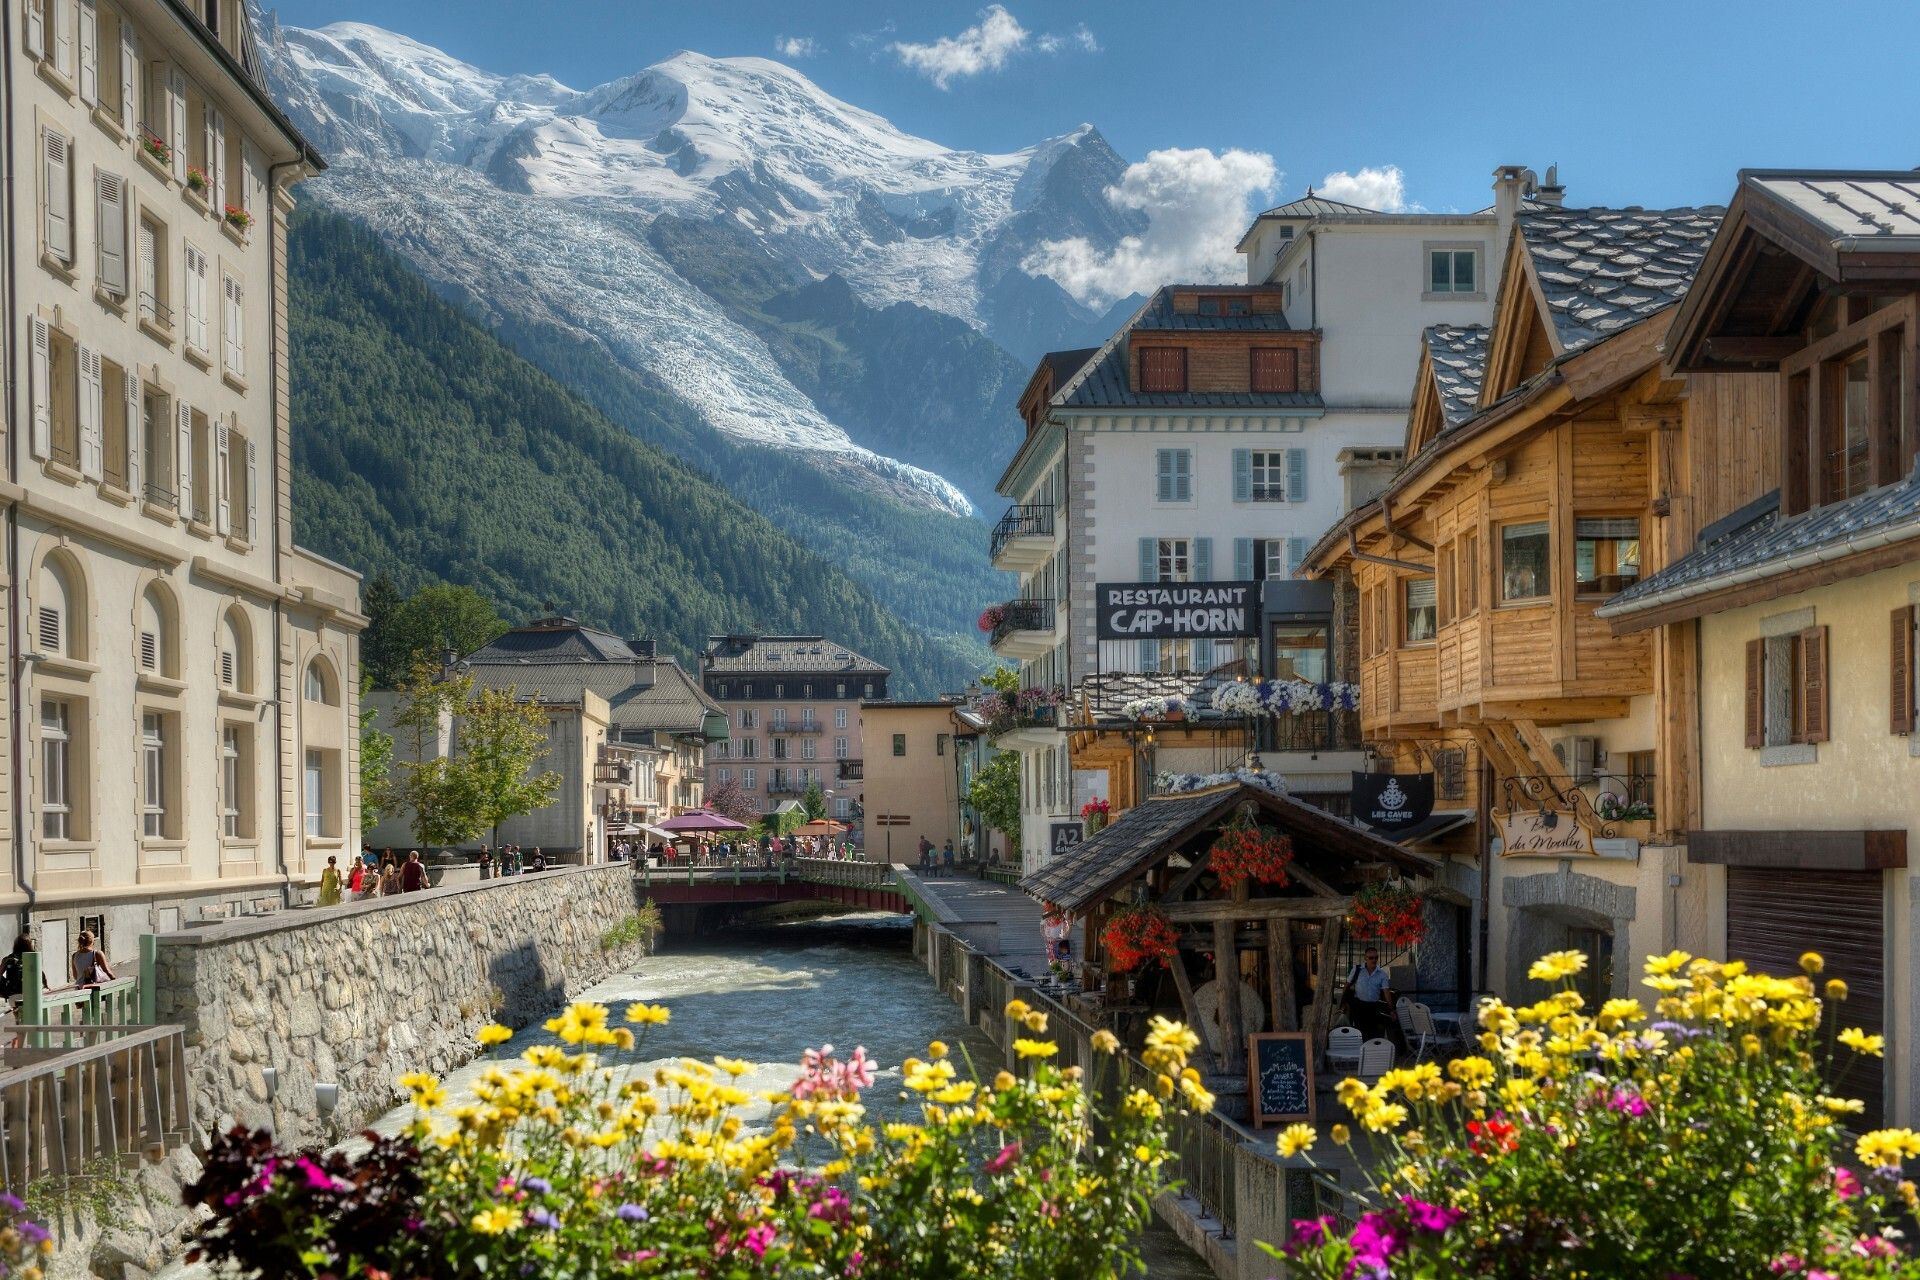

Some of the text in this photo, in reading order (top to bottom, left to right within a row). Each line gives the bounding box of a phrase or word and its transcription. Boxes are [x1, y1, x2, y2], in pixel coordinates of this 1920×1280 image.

[1108, 587, 1247, 606] RESTAURANT
[1110, 607, 1245, 633] CAP-HORN
[1371, 810, 1413, 819] LES CAVES
[1056, 828, 1079, 845] A2
[1510, 826, 1584, 850] du Moulin
[1055, 845, 1073, 853] Galer
